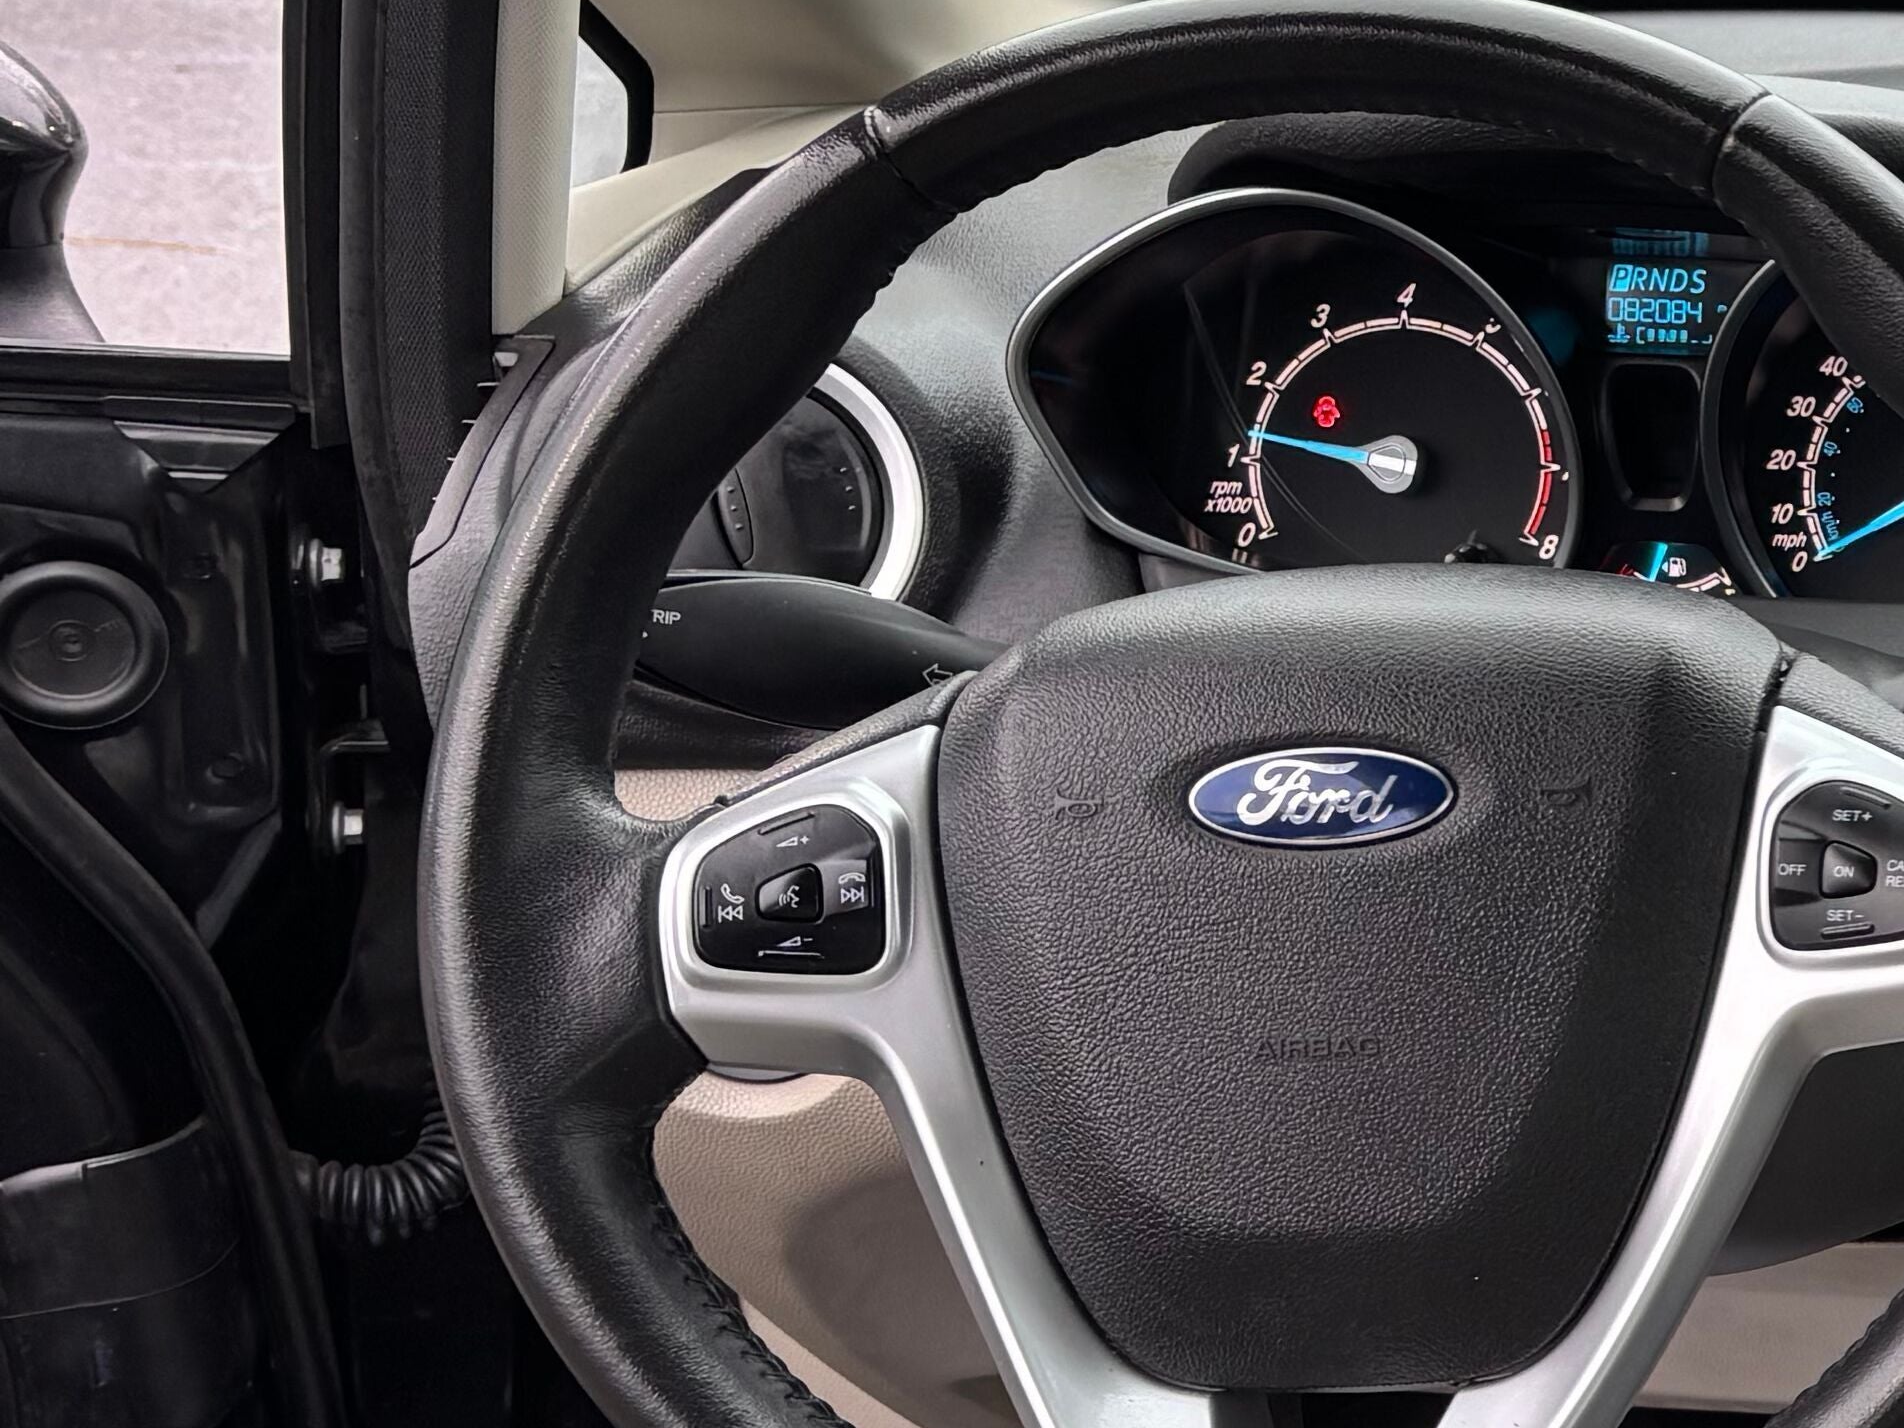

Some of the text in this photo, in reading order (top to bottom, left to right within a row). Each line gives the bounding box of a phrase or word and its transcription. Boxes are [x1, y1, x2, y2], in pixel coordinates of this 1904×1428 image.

[1397, 282, 1417, 308] 4
[1309, 303, 1331, 329] 3
[1607, 297, 1703, 324] 082084
[1245, 361, 1268, 386] 2
[1819, 355, 1849, 377] 40
[1786, 395, 1817, 418] 30
[1226, 443, 1241, 468] 1
[1766, 448, 1797, 471] 20
[1209, 480, 1244, 498] rpm
[1817, 491, 1832, 507] 20
[1204, 496, 1252, 515] x1000
[1770, 502, 1794, 525] 10
[1237, 522, 1257, 548] 0
[1772, 532, 1808, 552] mph
[1537, 534, 1560, 560] 8
[1791, 550, 1808, 573] 0
[651, 608, 682, 625] RIP
[1236, 759, 1399, 826] Ford
[1832, 809, 1873, 822] SET+
[1777, 863, 1807, 877] OFF
[1833, 865, 1855, 878] ON
[1254, 1035, 1381, 1061] AIRBAG
